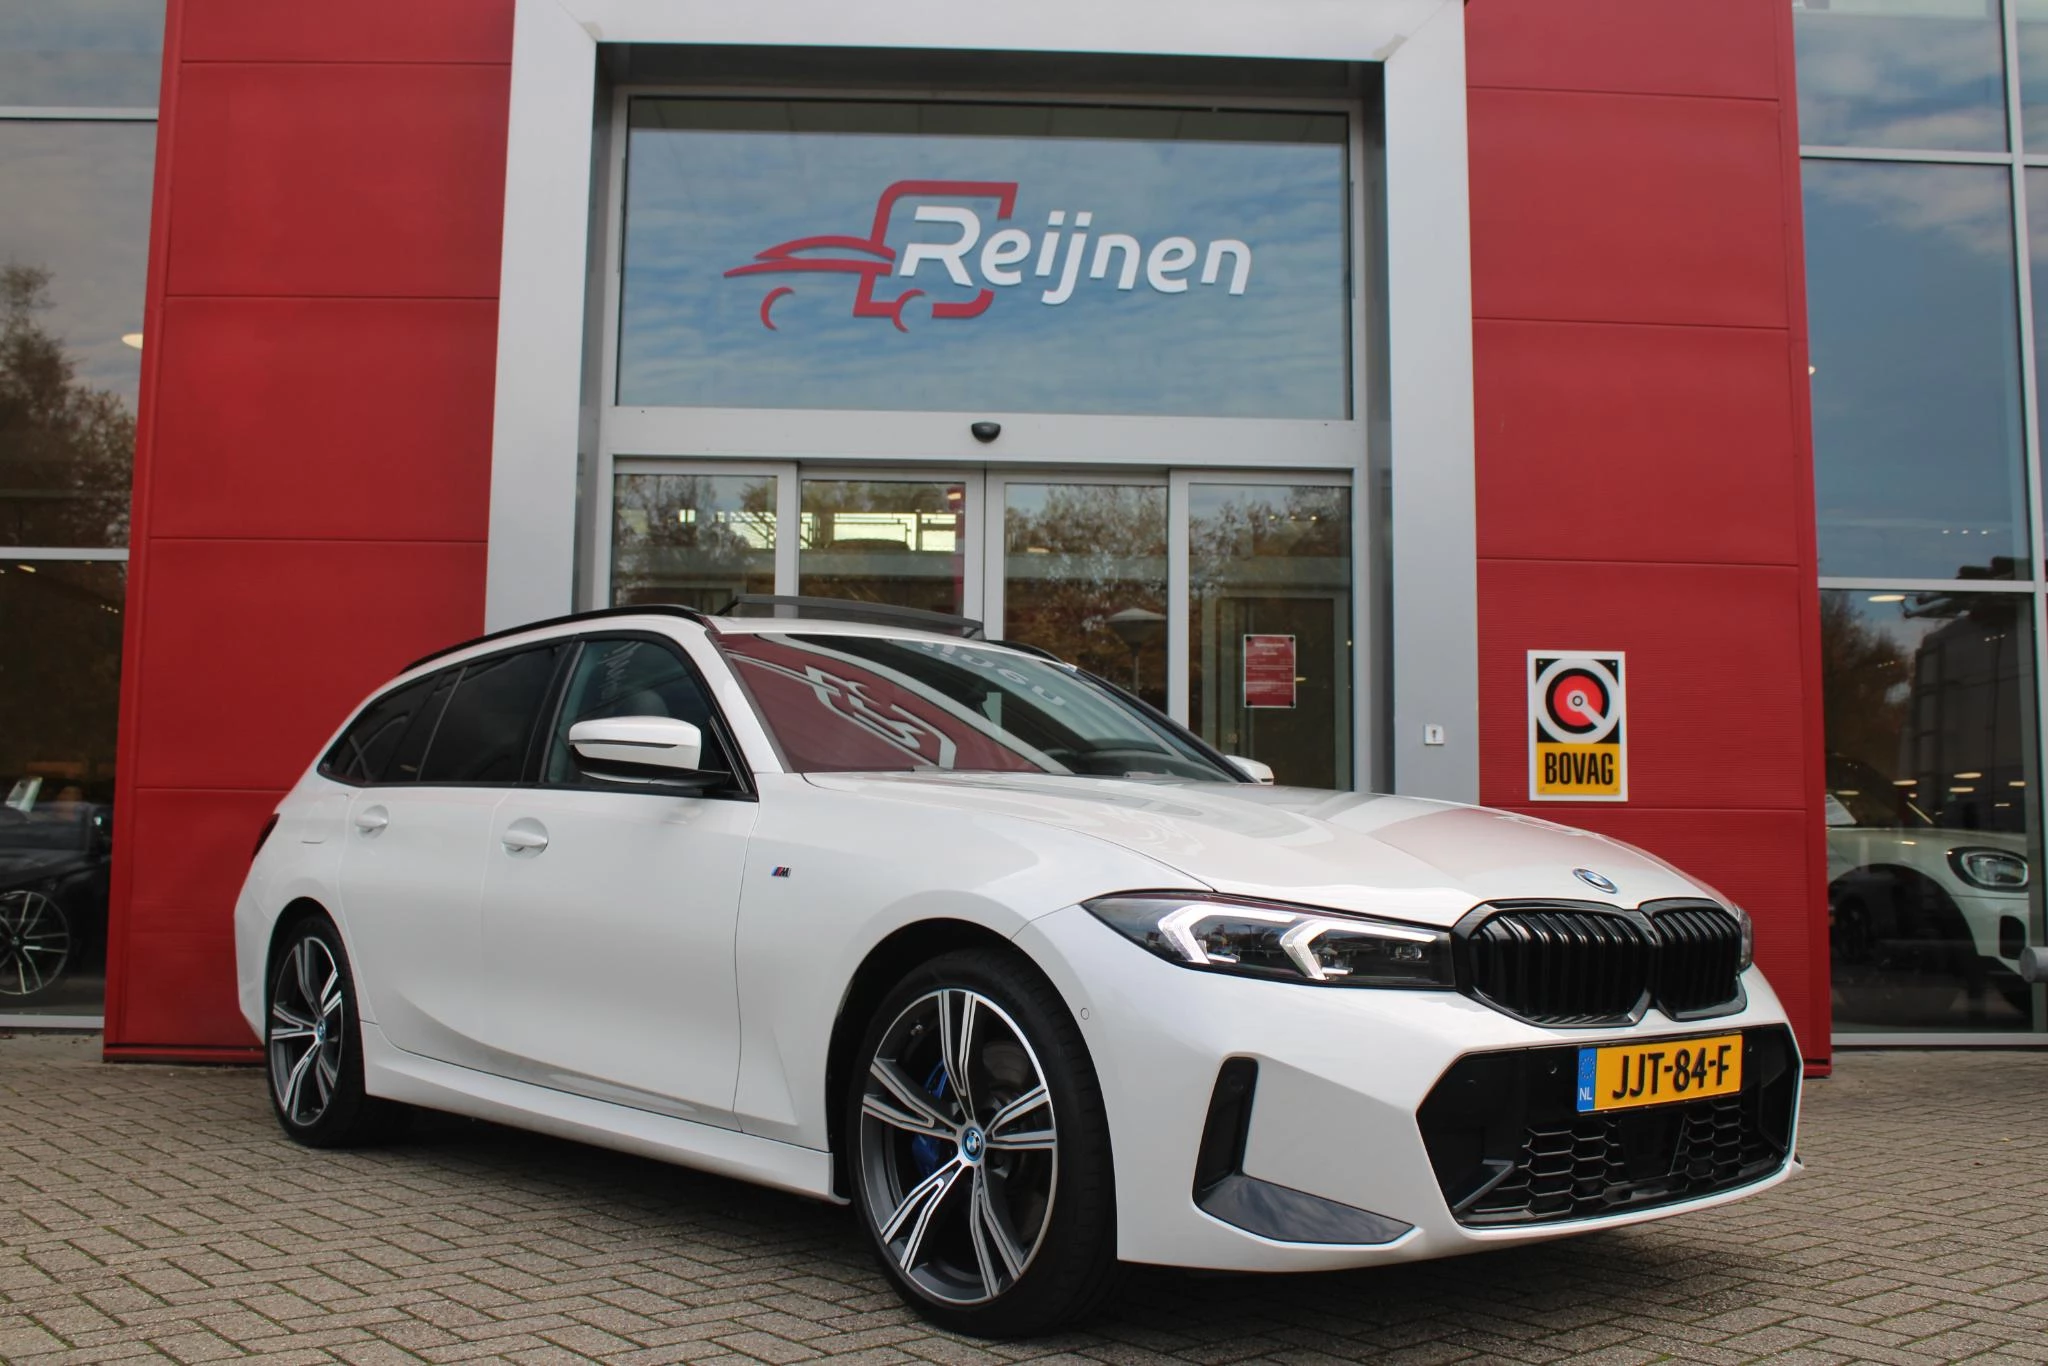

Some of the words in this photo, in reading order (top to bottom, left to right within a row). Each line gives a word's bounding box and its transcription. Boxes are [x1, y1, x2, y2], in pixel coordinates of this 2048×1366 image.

[899, 205, 1251, 306] Reijnen
[1545, 752, 1613, 785] BOVAG
[1579, 1087, 1593, 1101] NL
[1612, 1045, 1731, 1100] JJT-84-F
